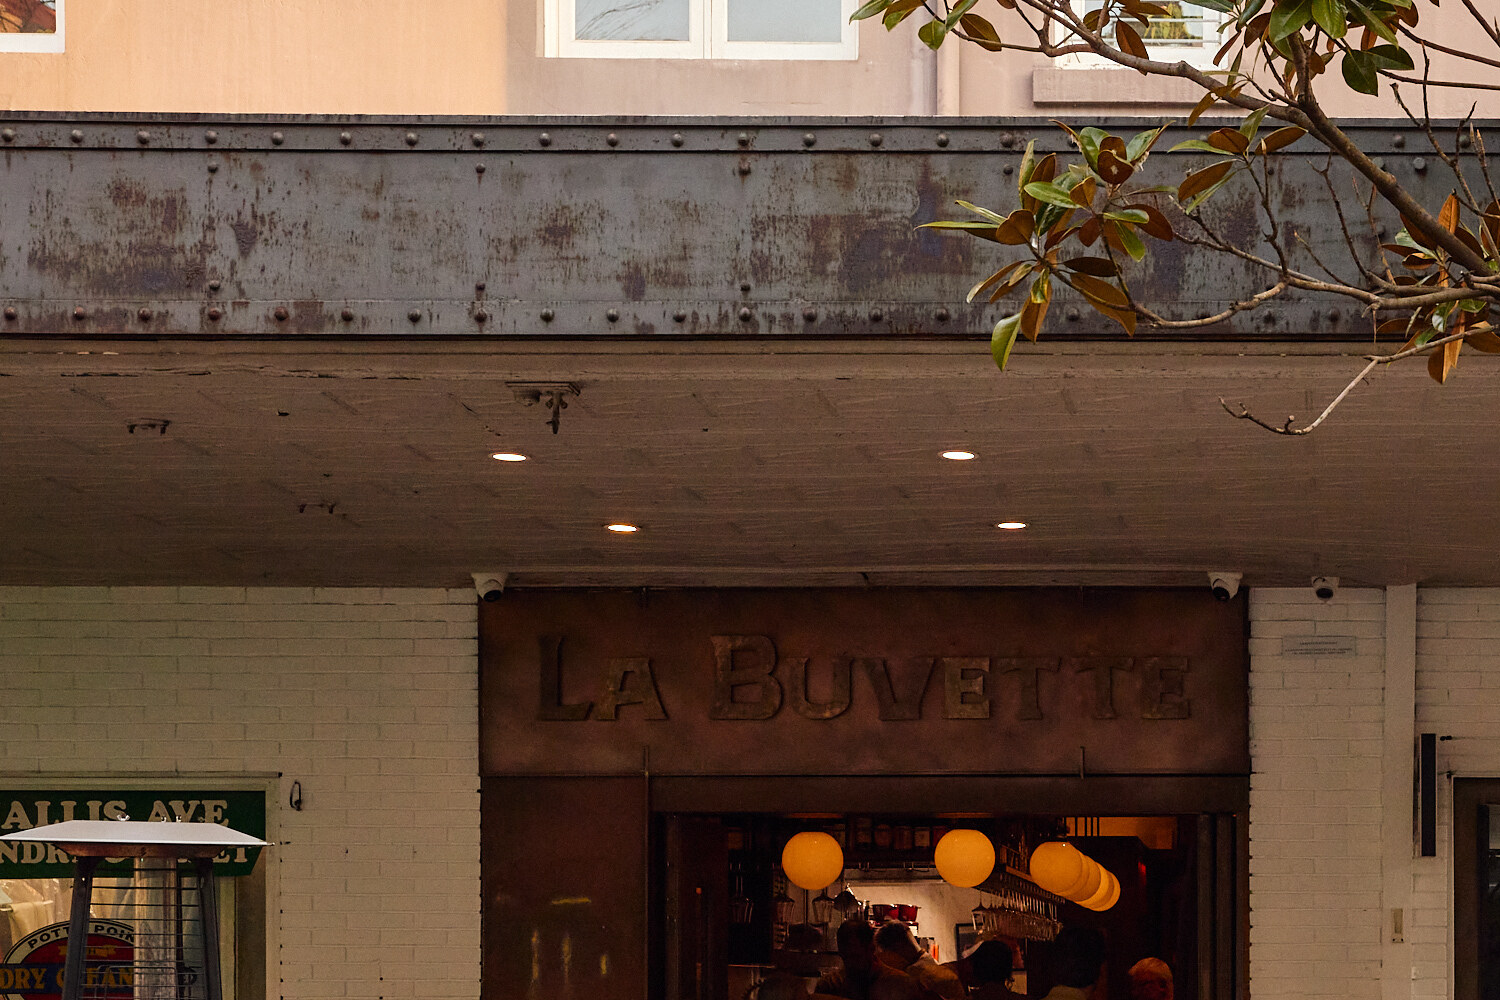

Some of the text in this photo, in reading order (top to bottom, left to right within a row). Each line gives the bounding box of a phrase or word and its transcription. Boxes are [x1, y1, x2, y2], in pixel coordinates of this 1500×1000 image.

[536, 633, 1192, 721] LA BUVETTE
[148, 800, 229, 828] AVE
